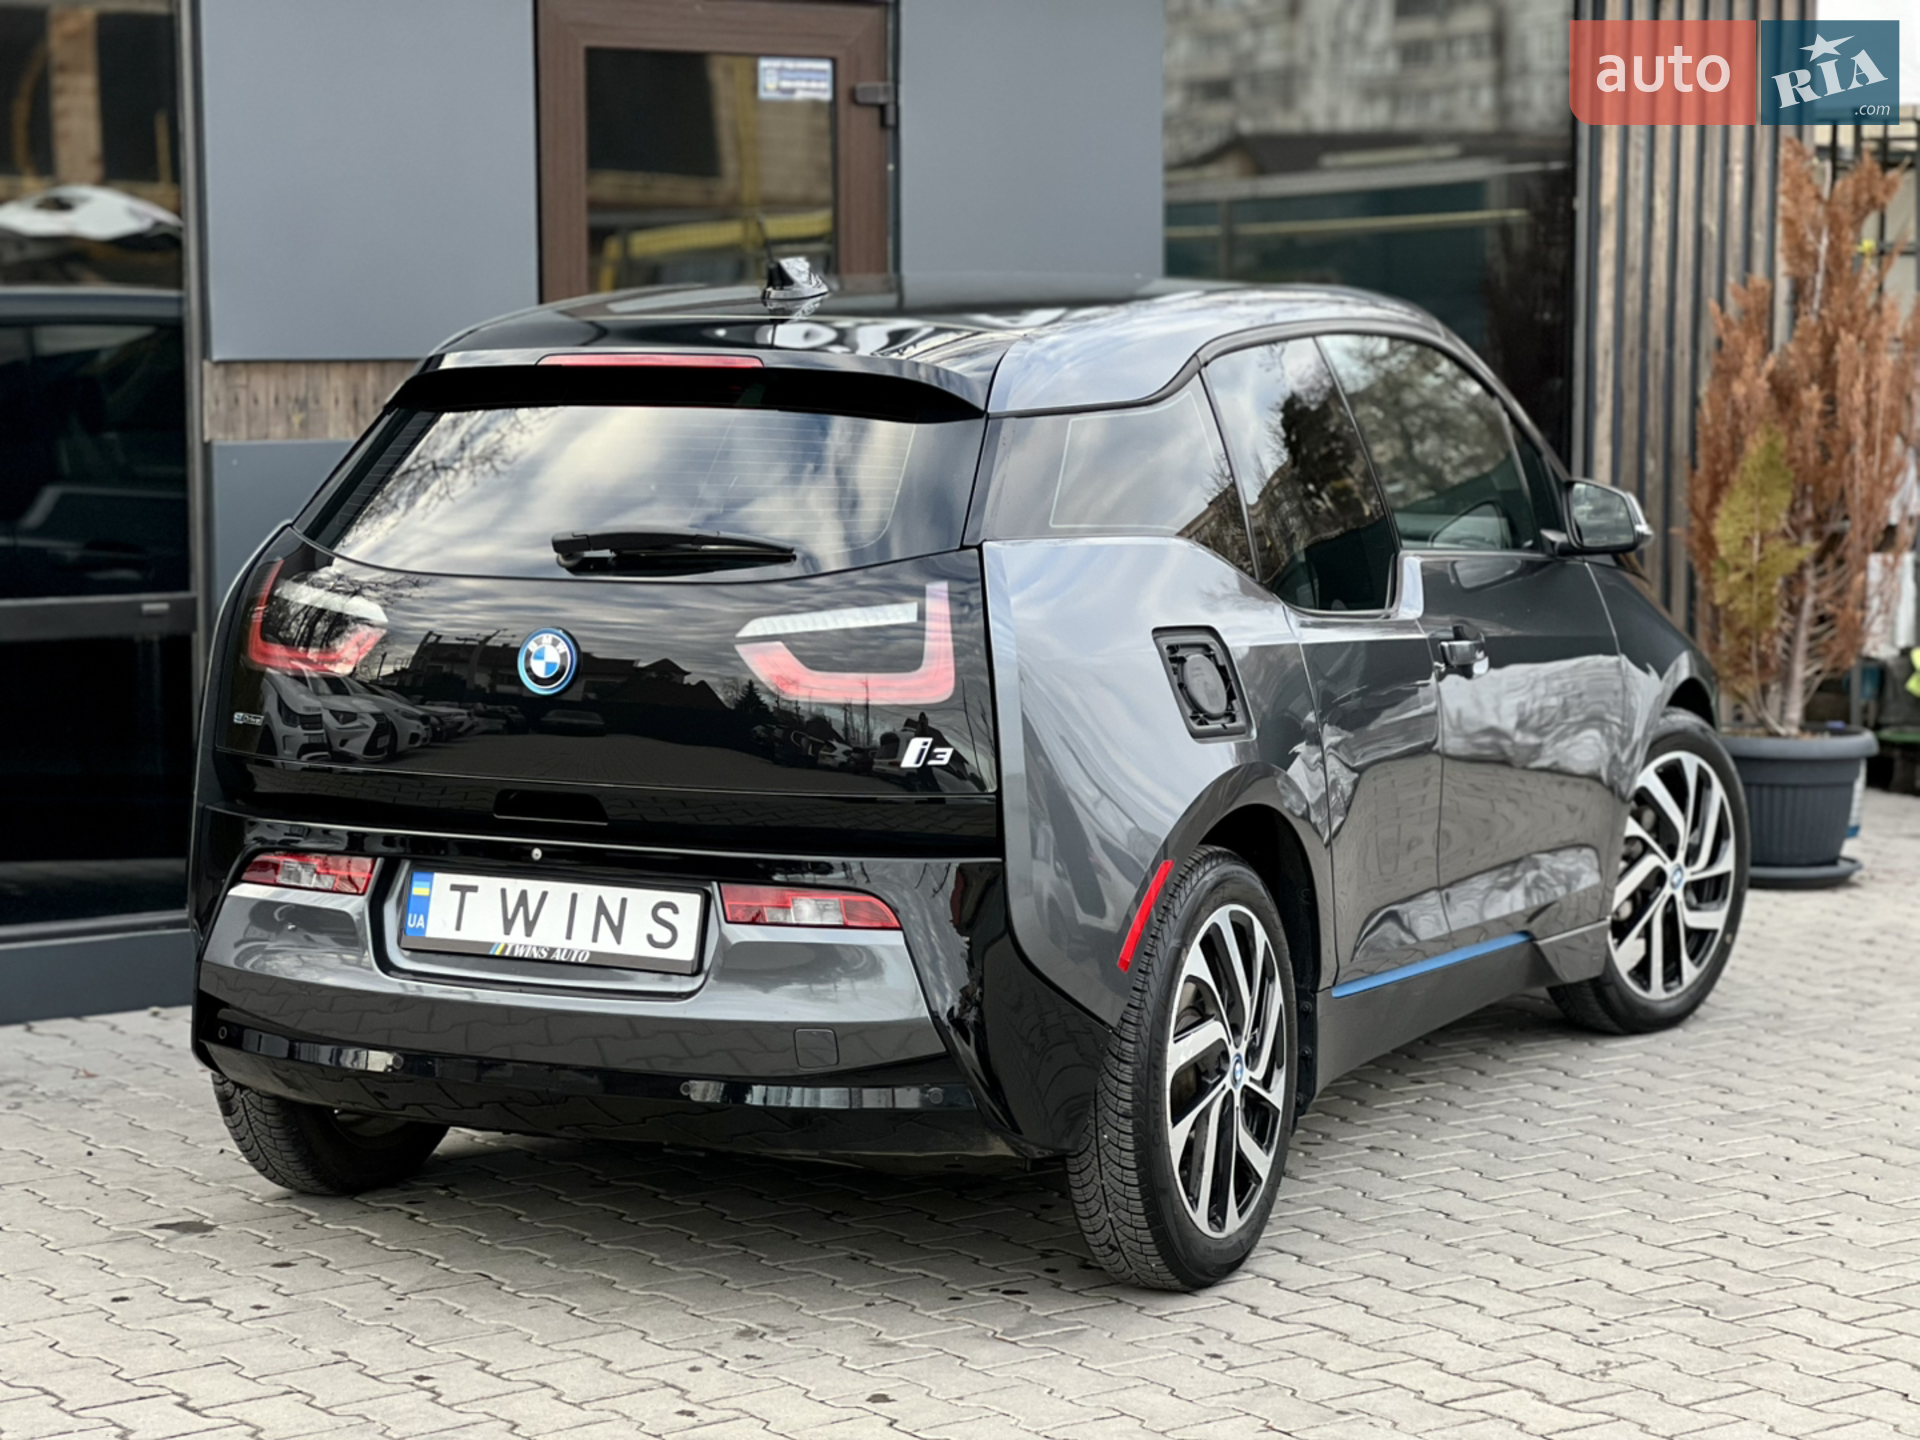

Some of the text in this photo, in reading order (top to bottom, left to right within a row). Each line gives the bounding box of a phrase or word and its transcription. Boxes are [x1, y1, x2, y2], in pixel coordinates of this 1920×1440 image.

[900, 736, 954, 768] i3
[407, 913, 425, 929] UA
[449, 883, 680, 950] TWINS
[504, 943, 590, 963] TWINS AUTO
